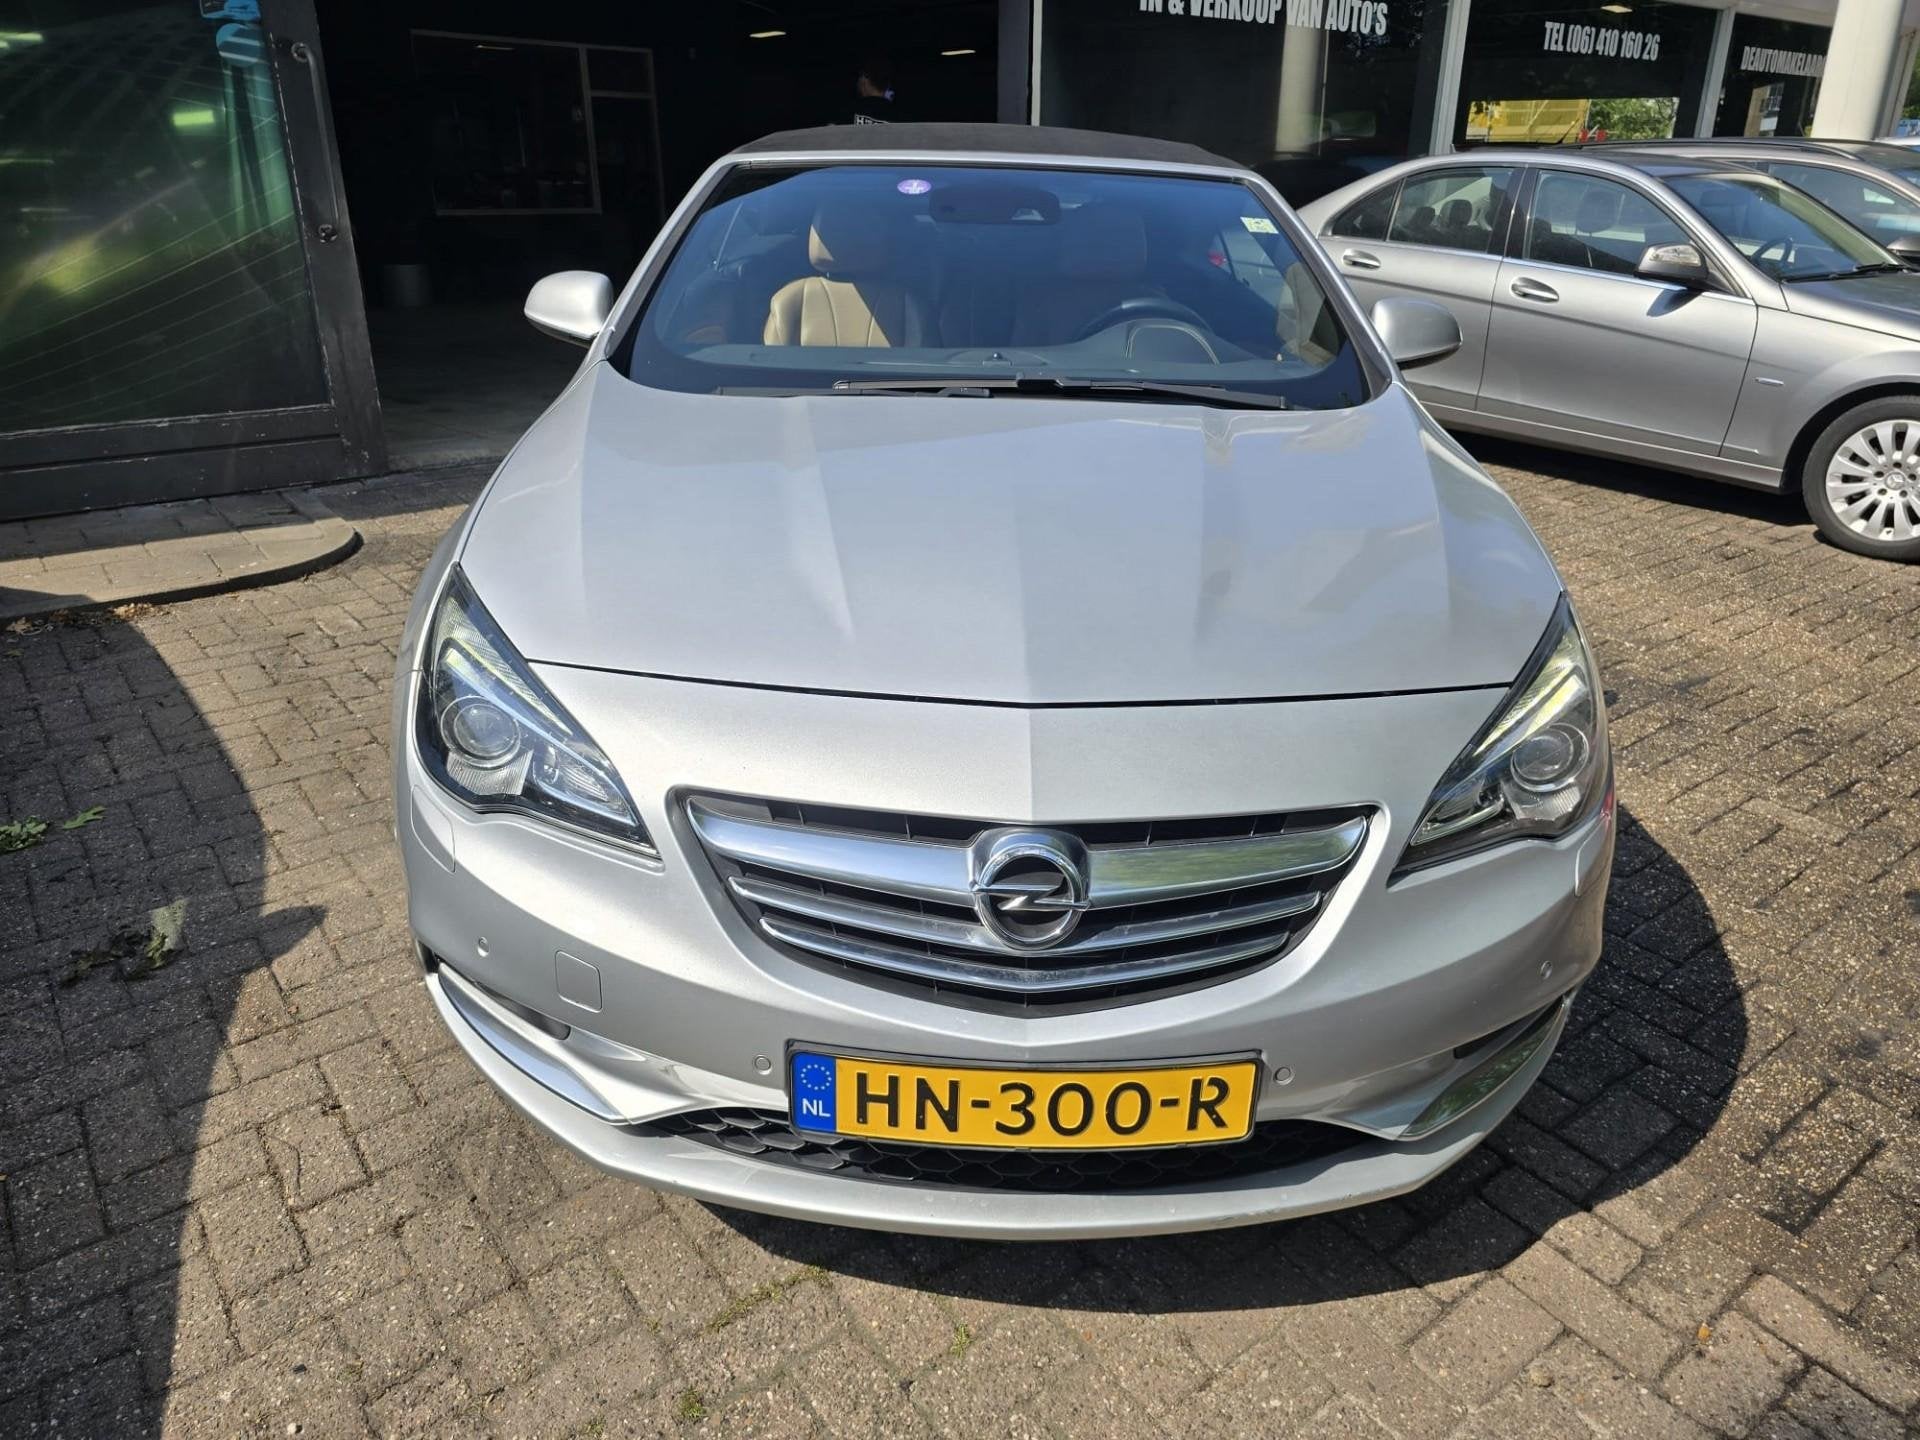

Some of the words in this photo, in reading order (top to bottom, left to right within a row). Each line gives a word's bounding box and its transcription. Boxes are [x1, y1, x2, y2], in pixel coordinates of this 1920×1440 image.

[1286, 0, 1323, 29] VAN
[1324, 0, 1388, 36] AUTO'S
[1543, 21, 1565, 51] TEL
[1566, 24, 1596, 55] (06)
[1595, 28, 1620, 57] 410
[1620, 30, 1643, 60] 160
[1642, 33, 1661, 61] 26
[802, 1098, 831, 1118] NL
[856, 1071, 1229, 1136] HN-300-R
